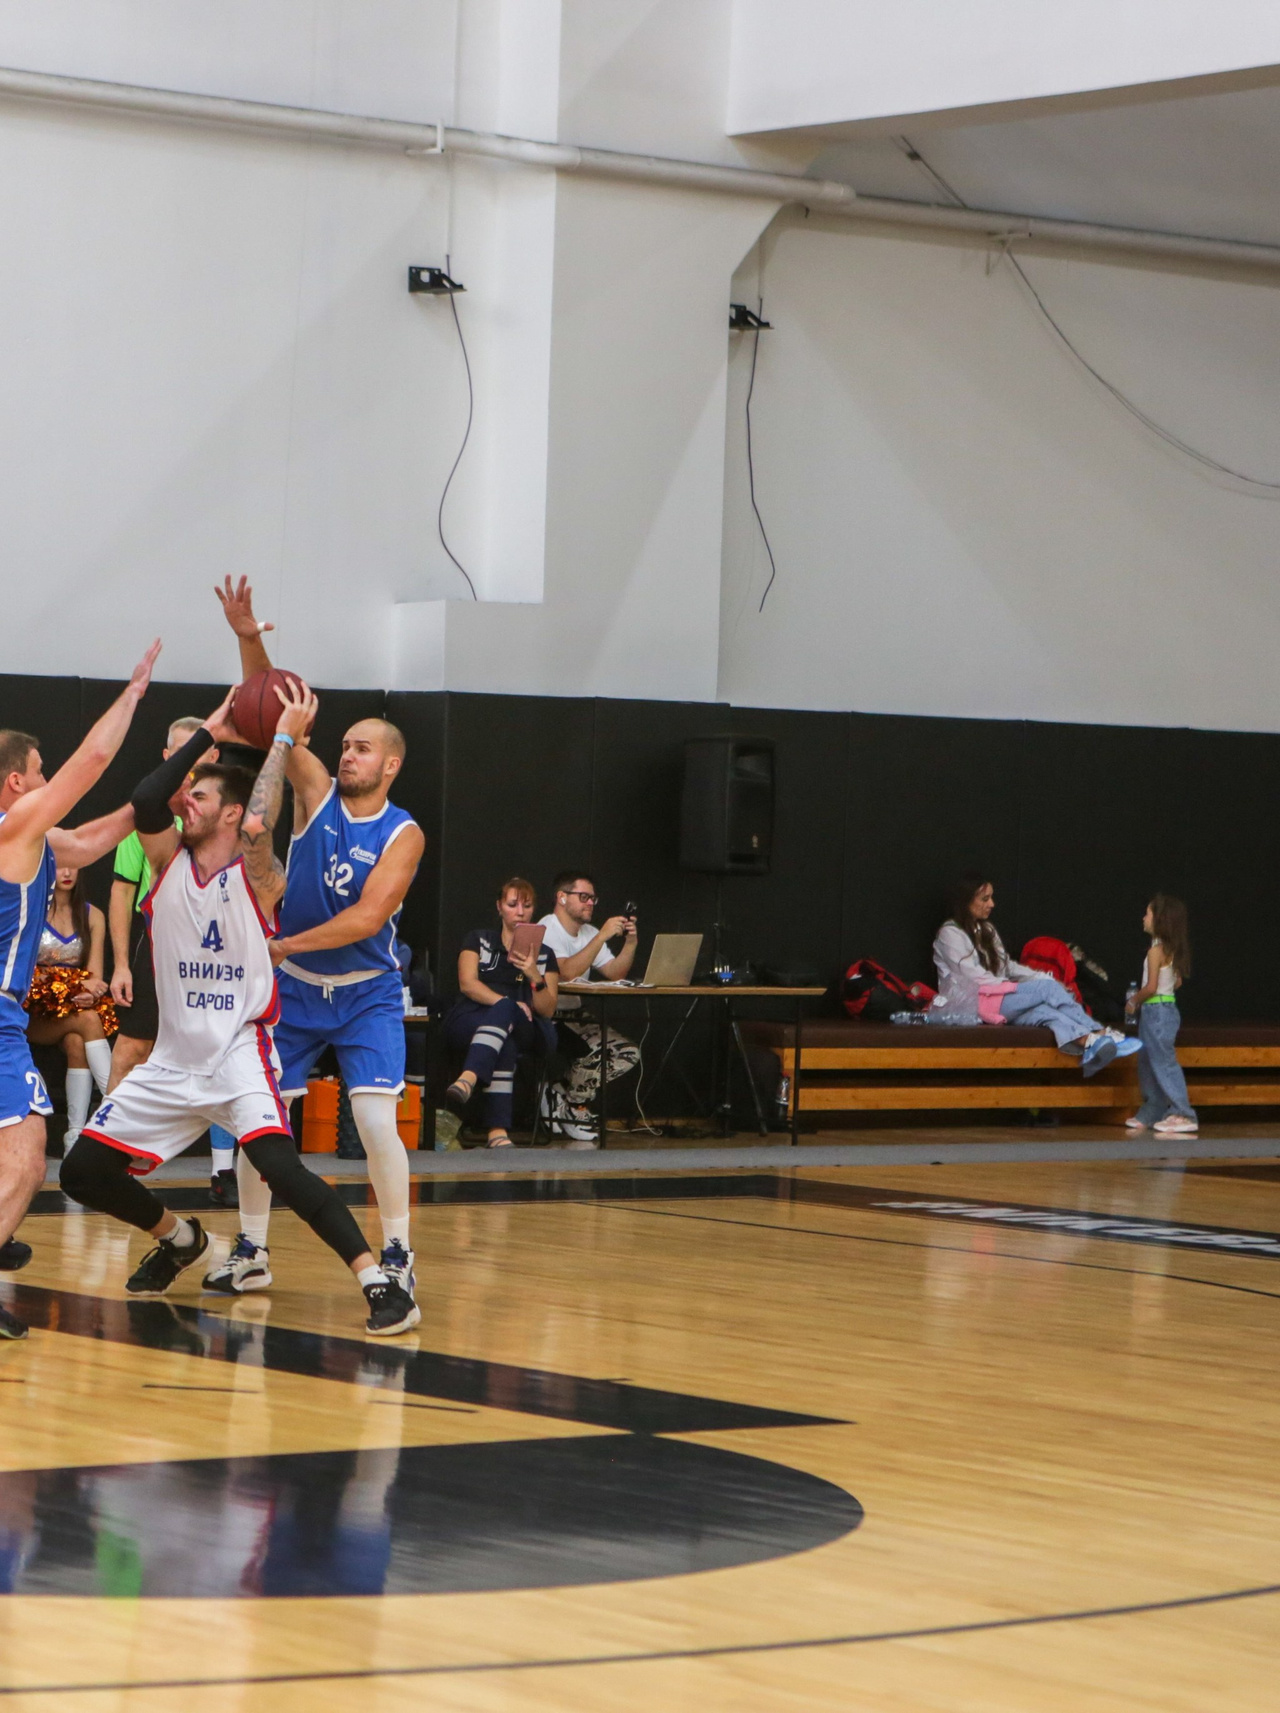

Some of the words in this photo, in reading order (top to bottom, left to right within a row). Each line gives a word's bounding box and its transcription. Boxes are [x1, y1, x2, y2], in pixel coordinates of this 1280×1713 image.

[324, 853, 354, 897] 32
[201, 919, 224, 953] 4
[178, 961, 245, 982] ВНИИЭФ
[186, 991, 235, 1011] САРОВ
[94, 1102, 115, 1127] 4
